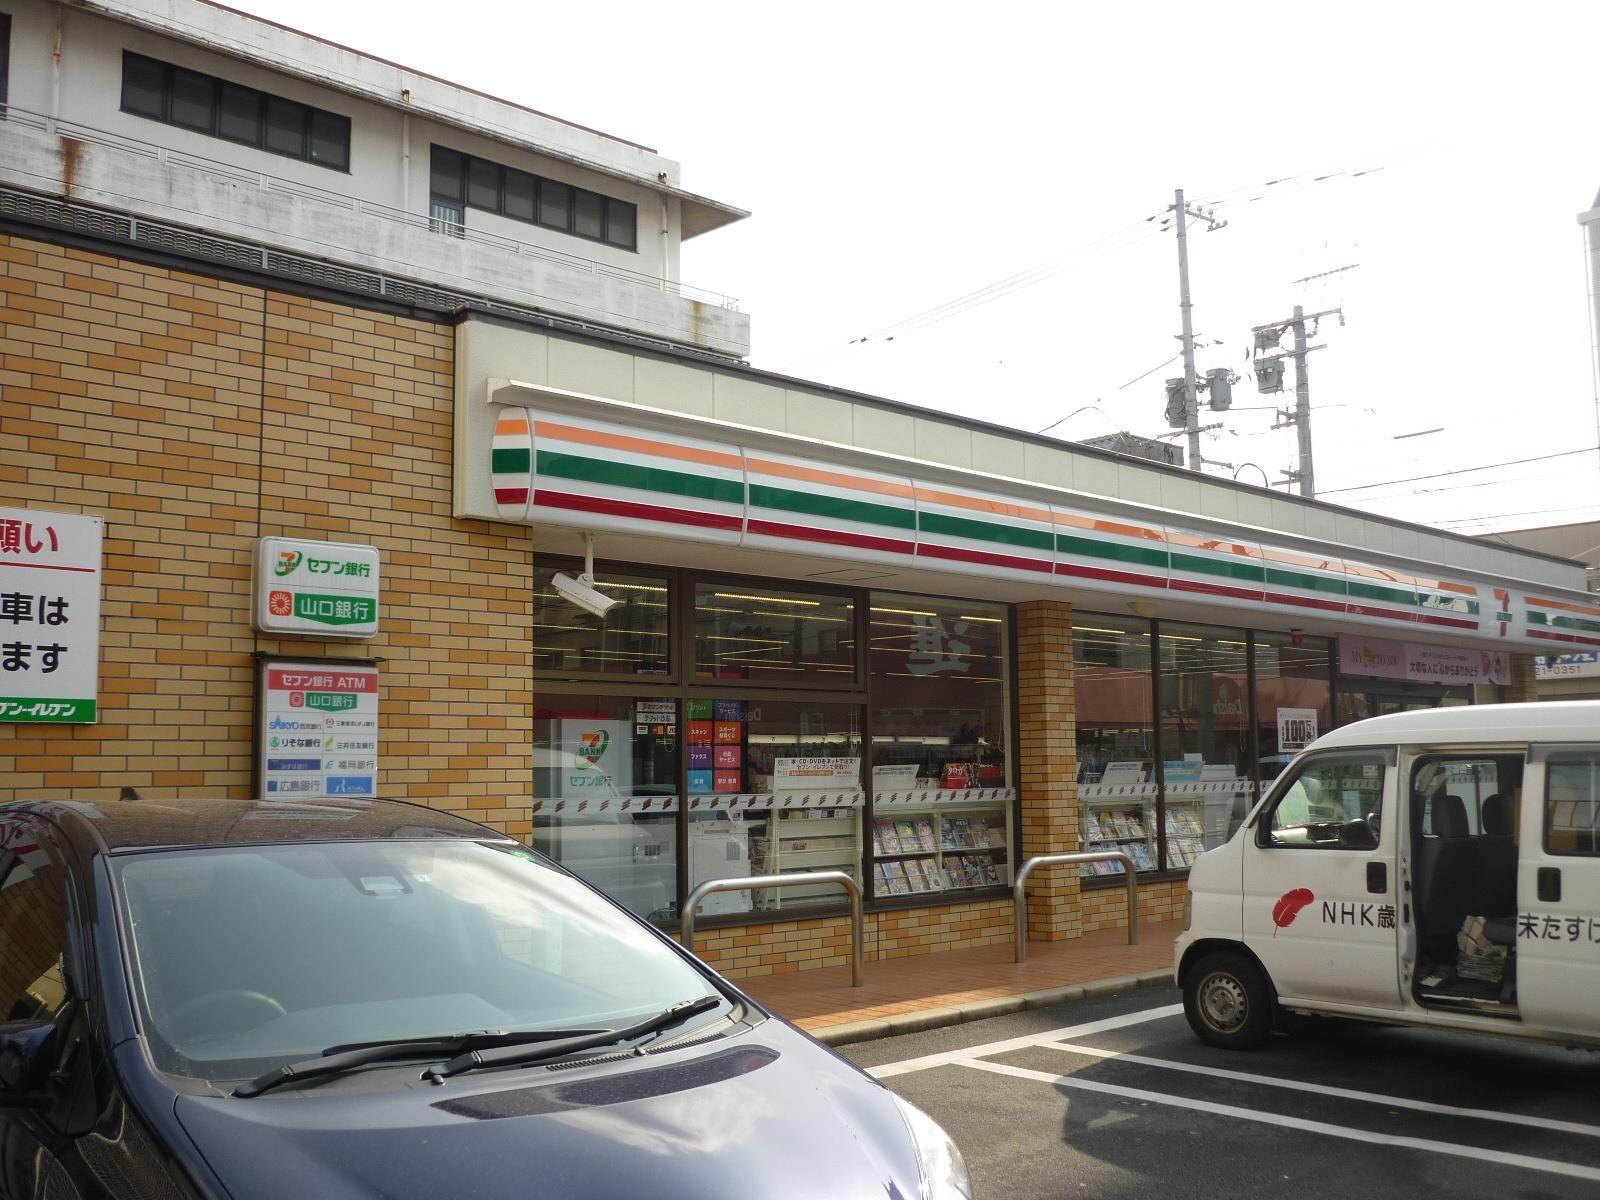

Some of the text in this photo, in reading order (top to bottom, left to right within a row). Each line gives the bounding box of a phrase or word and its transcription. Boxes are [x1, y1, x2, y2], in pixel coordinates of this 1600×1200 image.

[307, 558, 371, 578] セブン銀行
[0, 592, 69, 626] 車は
[301, 597, 368, 620] 山口銀行
[2, 641, 68, 674] ます
[282, 674, 366, 688] セブン銀行 ATM
[309, 695, 353, 708] 山口銀行
[281, 738, 320, 748] りそな銀行
[279, 780, 320, 792] 広島銀行
